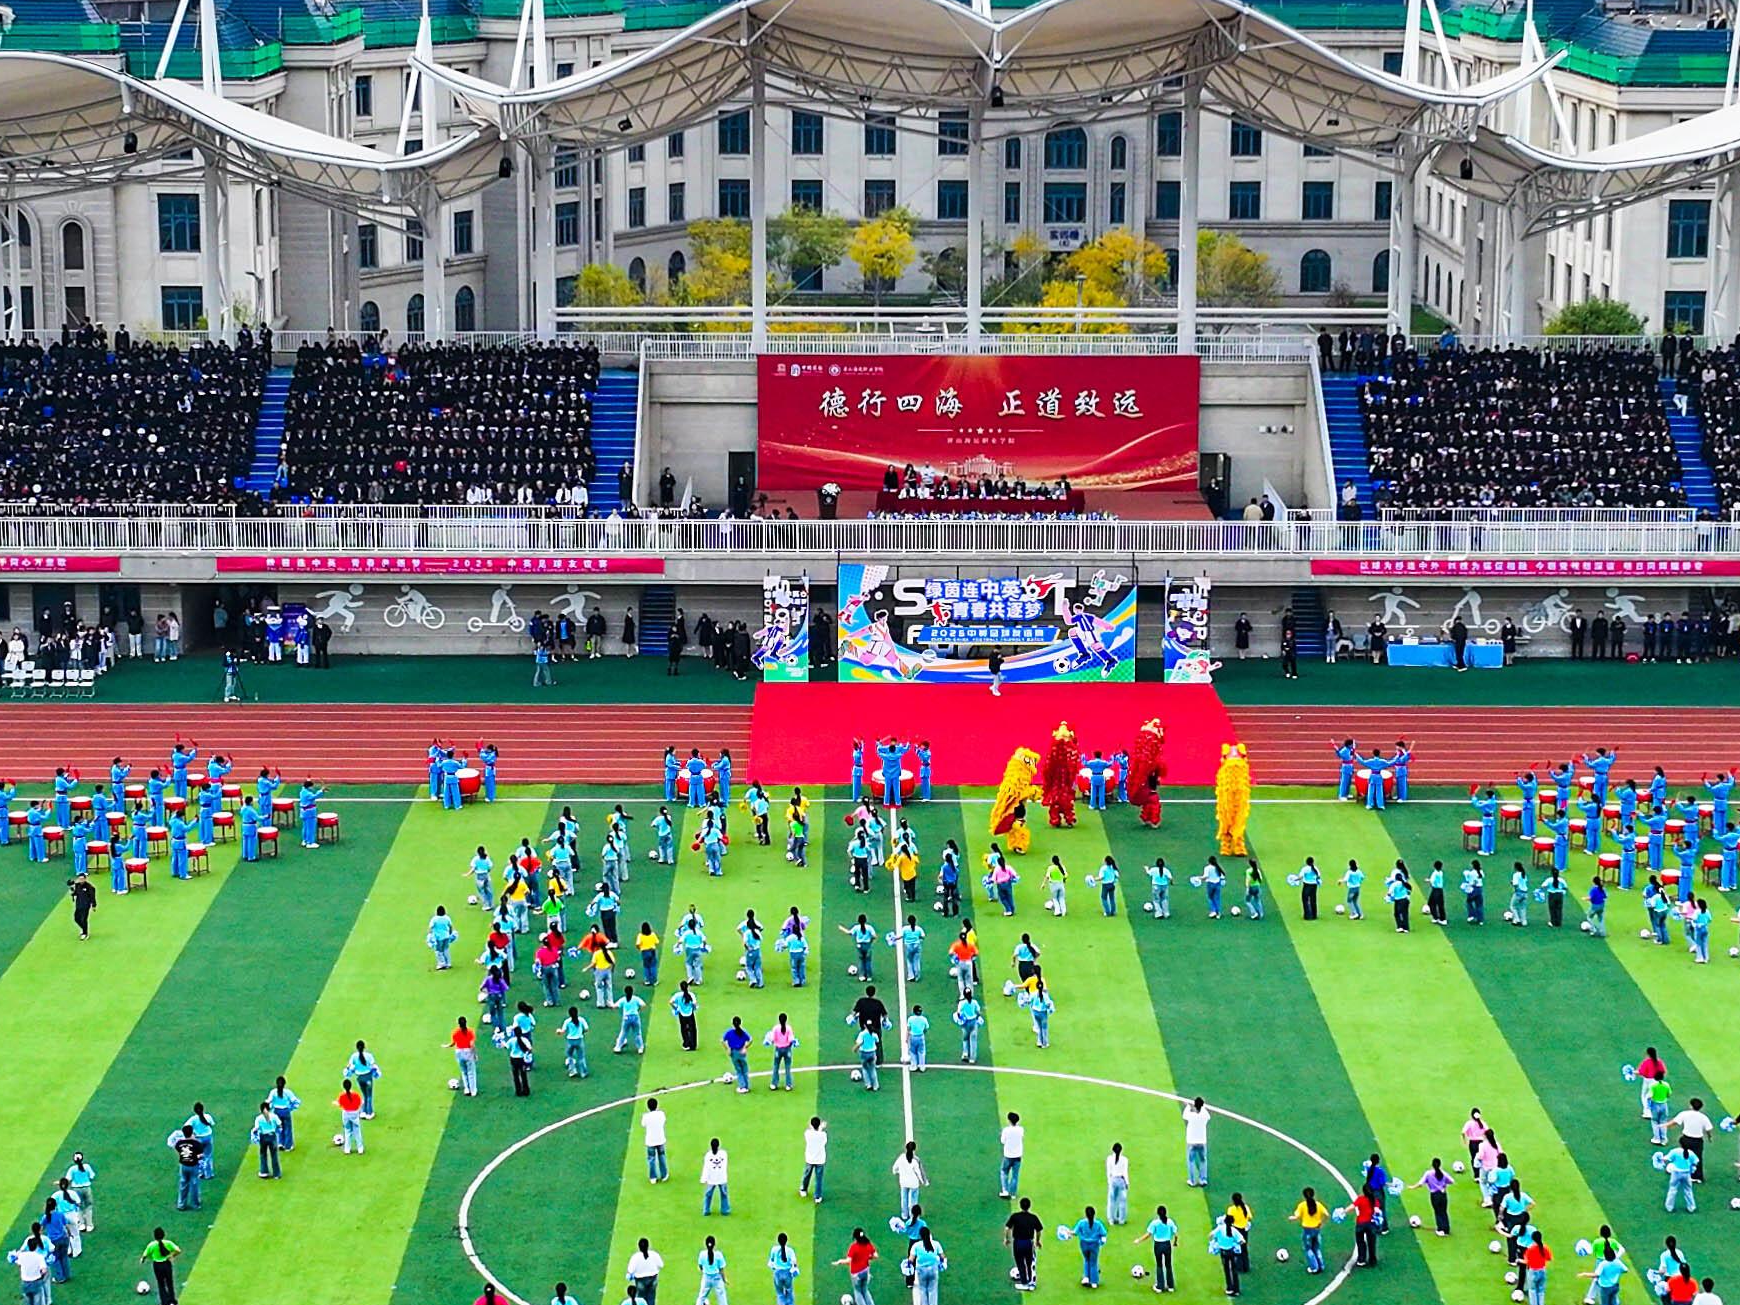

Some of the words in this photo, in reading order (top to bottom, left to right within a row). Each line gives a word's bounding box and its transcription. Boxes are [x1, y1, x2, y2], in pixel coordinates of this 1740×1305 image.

[819, 386, 963, 419] 德行四海
[998, 388, 1144, 419] 正道致远
[925, 580, 1022, 599] 绿茵连中英
[953, 601, 1043, 619] 青春共逐梦
